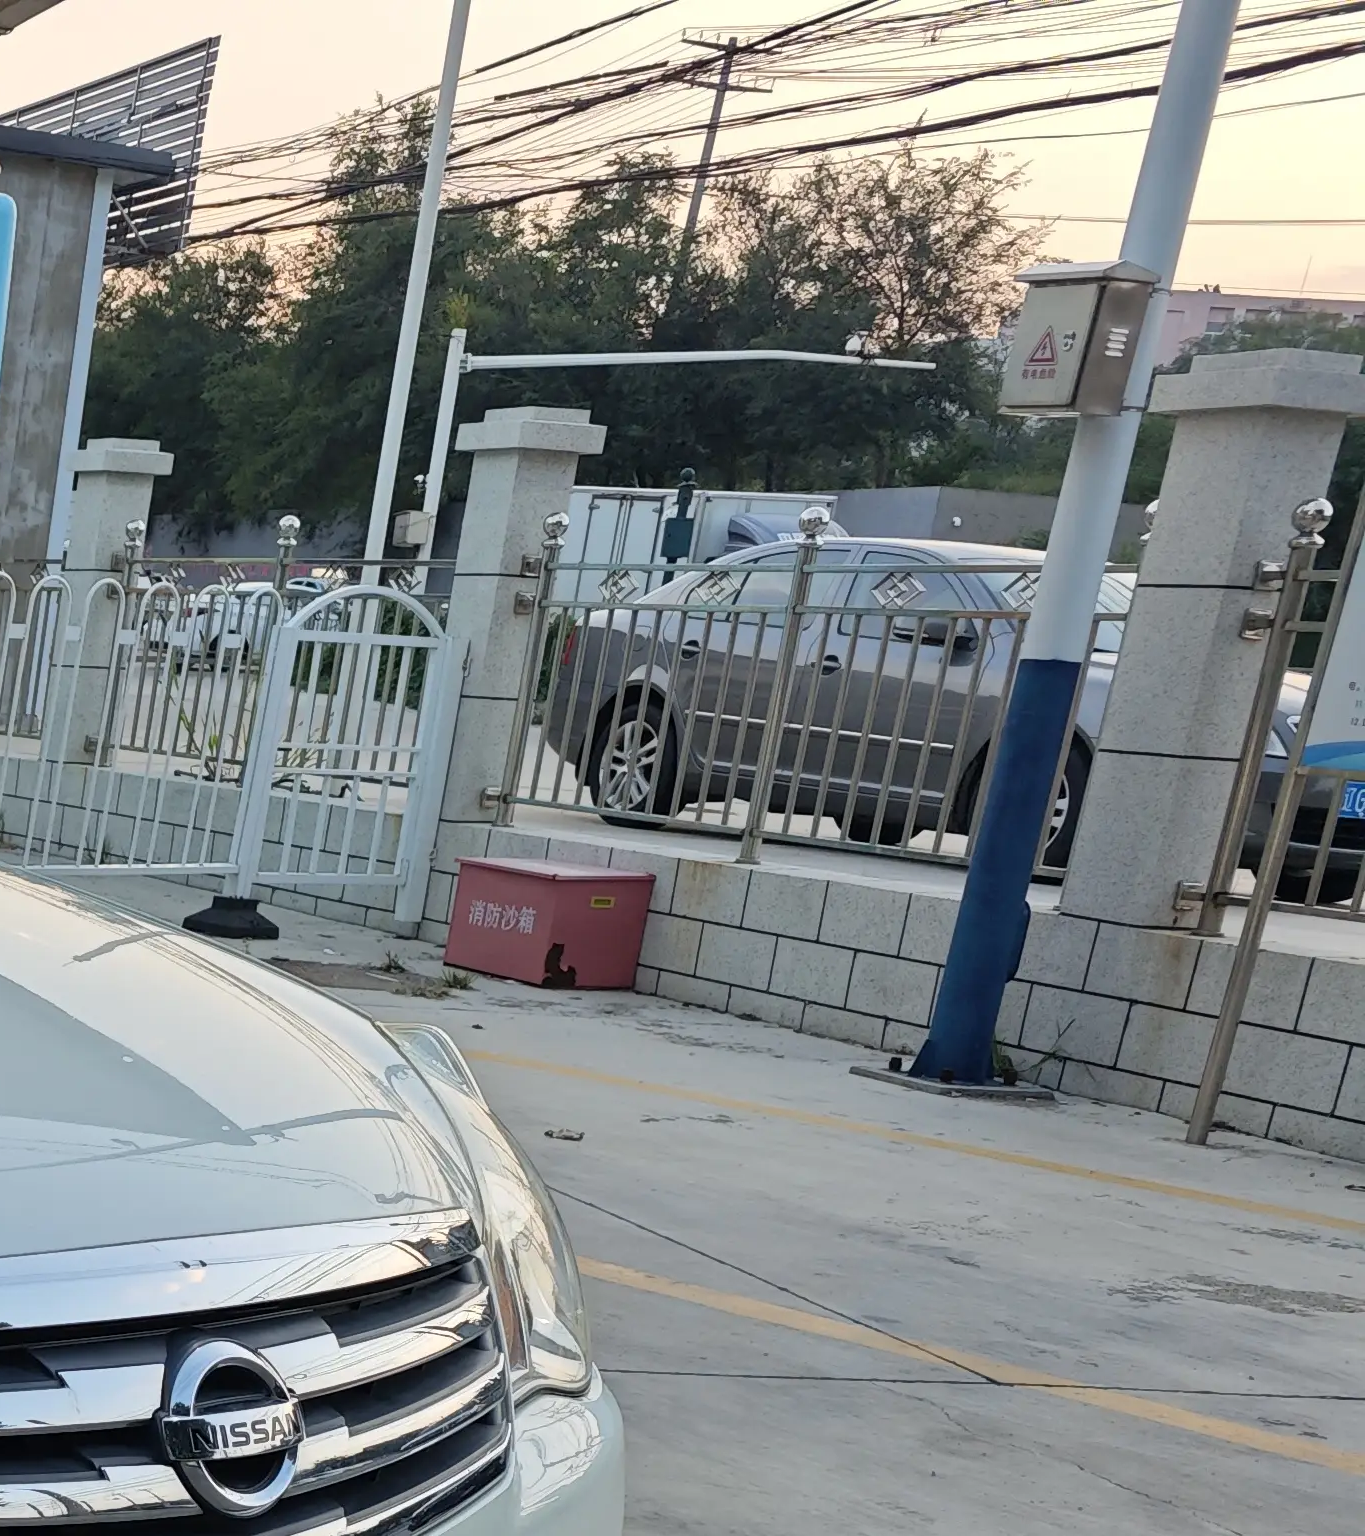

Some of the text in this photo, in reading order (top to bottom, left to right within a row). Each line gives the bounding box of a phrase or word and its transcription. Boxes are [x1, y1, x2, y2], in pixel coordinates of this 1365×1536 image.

[469, 899, 537, 935] 消防沙箱
[188, 1402, 303, 1453] NISSAN
